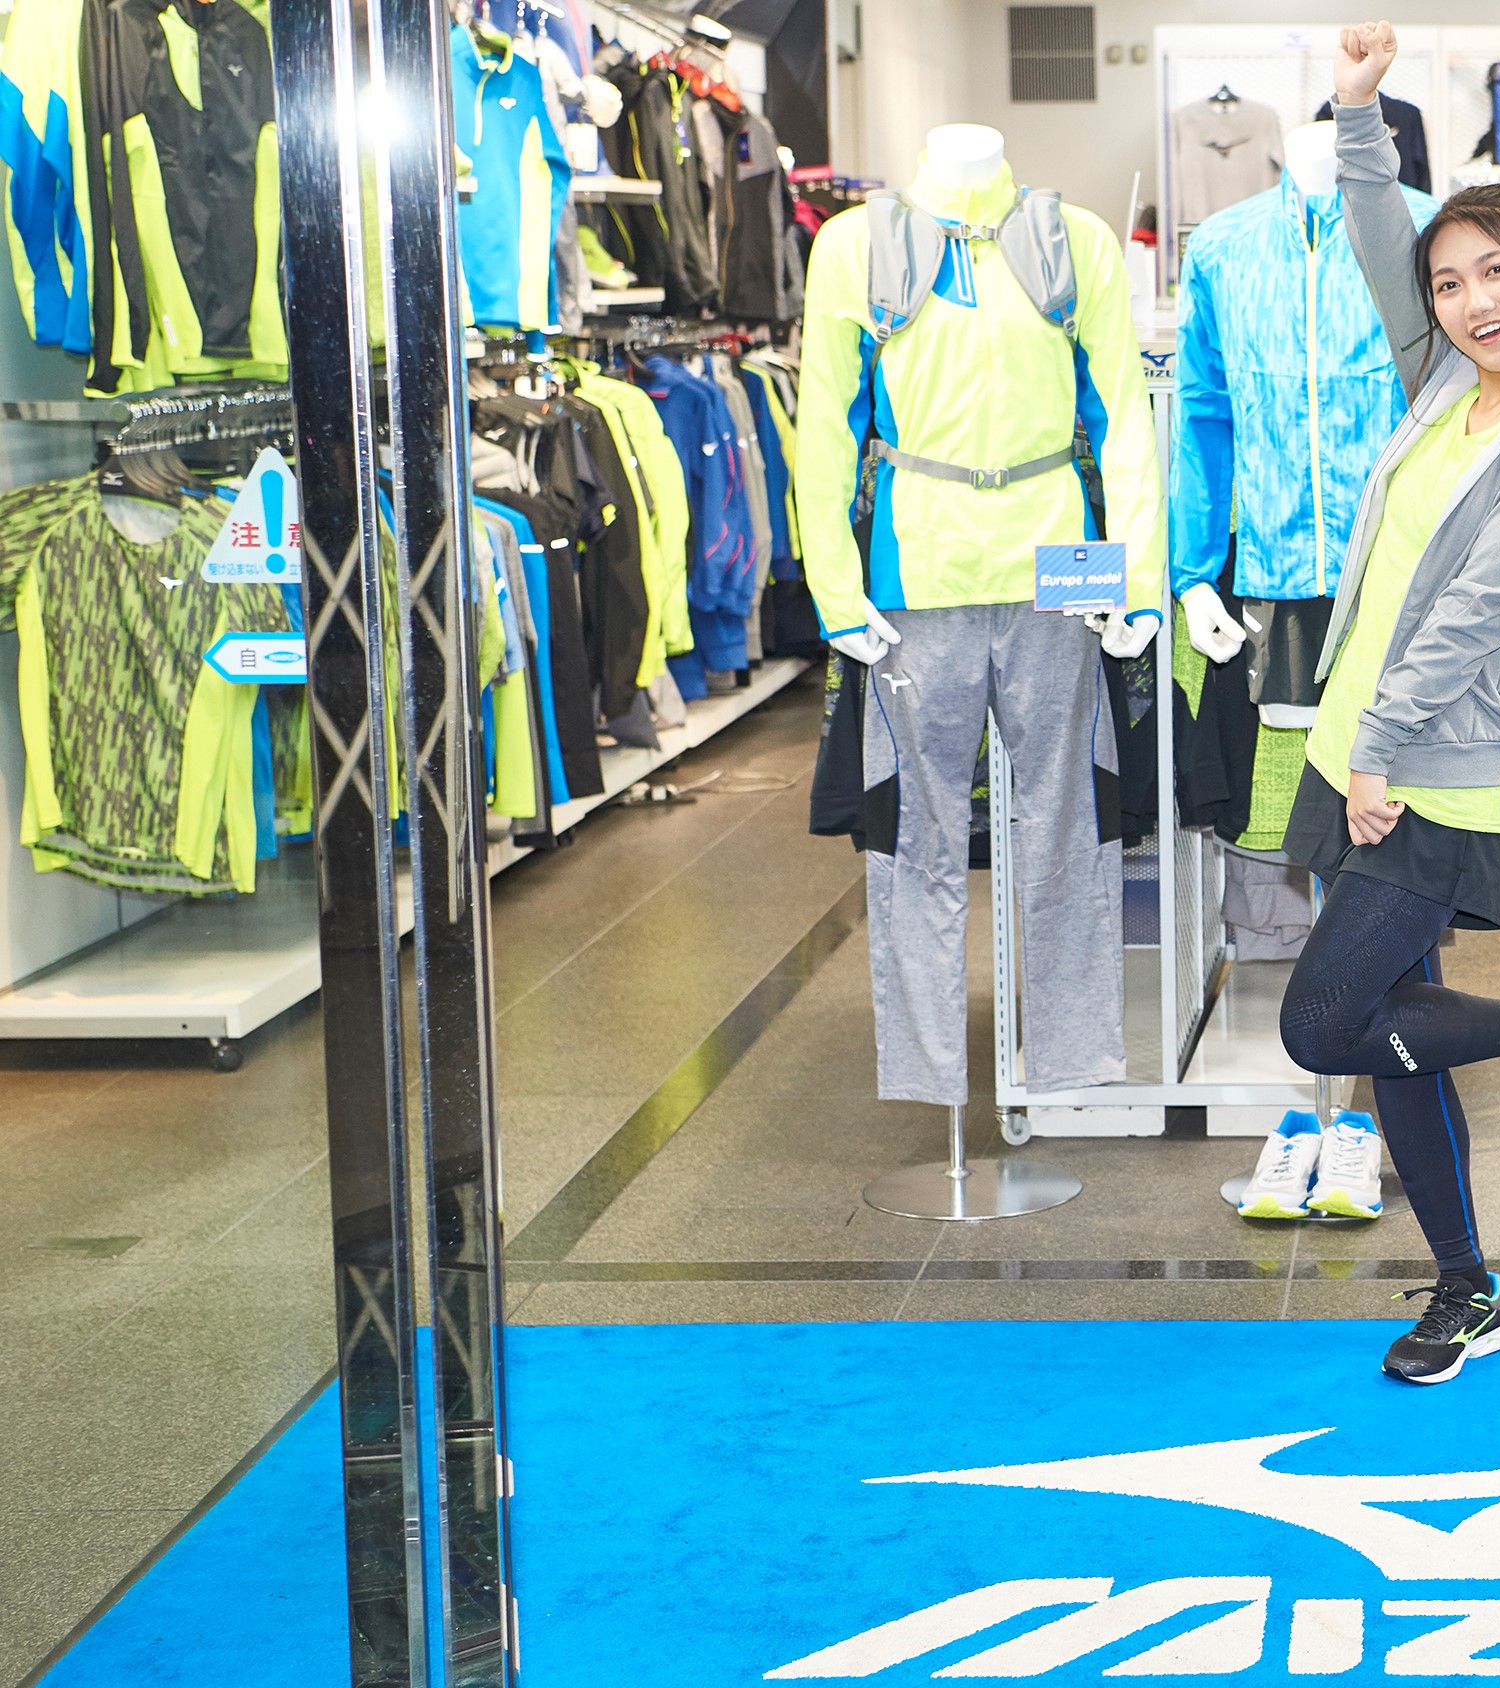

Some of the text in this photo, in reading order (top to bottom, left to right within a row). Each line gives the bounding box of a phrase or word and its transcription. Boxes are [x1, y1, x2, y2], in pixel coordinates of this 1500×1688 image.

[1040, 572, 1122, 588] Europe model
[241, 647, 256, 668] 自
